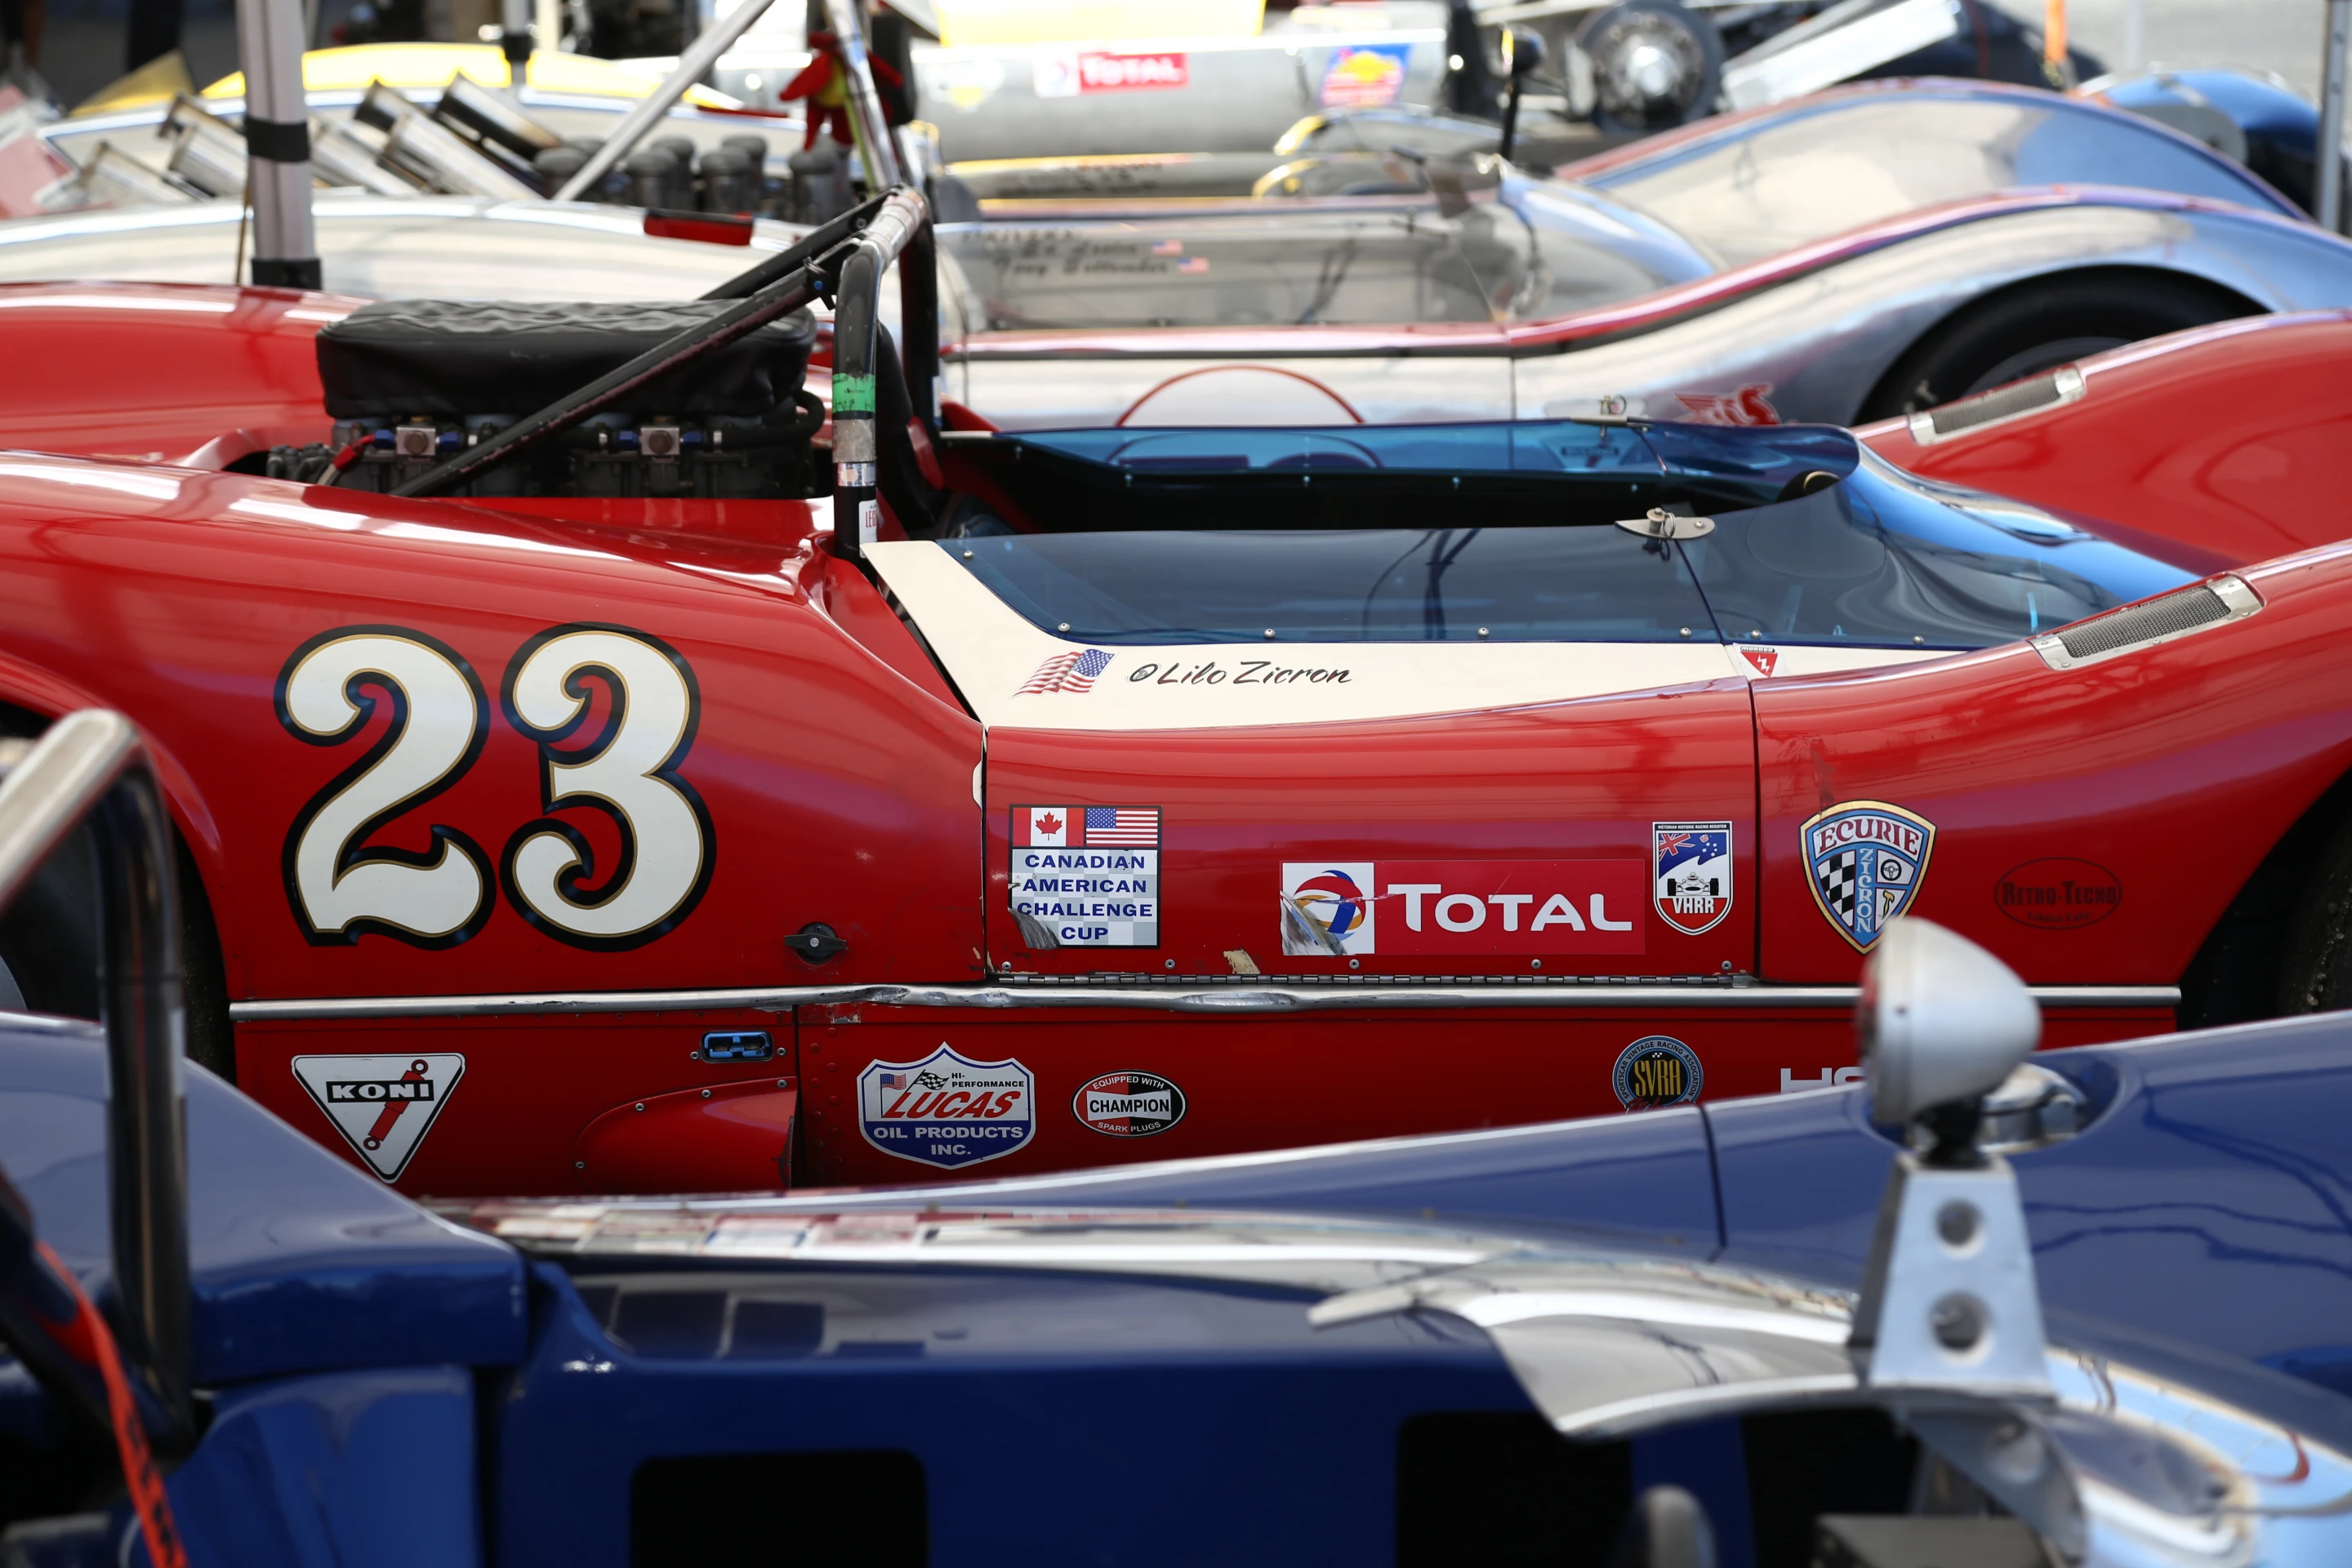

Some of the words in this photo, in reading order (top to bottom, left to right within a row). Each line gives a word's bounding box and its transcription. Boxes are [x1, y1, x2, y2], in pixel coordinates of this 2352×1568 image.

[1157, 662, 1227, 684] Lilo
[1232, 661, 1352, 684] Zicron
[274, 621, 717, 953] 23
[1818, 818, 1919, 856] ECURIE
[1025, 854, 1145, 869] CANADIAN
[1022, 879, 1147, 893] AMERICAN
[1855, 849, 1873, 933] ZICRON
[1017, 902, 1153, 917] CHALLENGE
[1388, 884, 1632, 932] TOTAL
[1673, 898, 1714, 914] VHRR
[1061, 927, 1108, 939] CUP
[1618, 1060, 1630, 1099] SPORTSCAR
[1626, 1041, 1655, 1060] VINTAGE
[1657, 1041, 1684, 1054] RACING
[1683, 1054, 1699, 1097] ASSOCIATION
[1092, 1076, 1139, 1090] EQUIPPED
[1142, 1077, 1165, 1089] WITH
[1634, 1059, 1681, 1097] SVRA
[332, 1084, 430, 1099] KONI
[882, 1091, 1021, 1118] LUCAS
[1089, 1099, 1169, 1112] CHAMPION
[873, 1127, 908, 1138] OIL
[915, 1126, 1023, 1138] PRODUCTS
[1098, 1121, 1128, 1132] SPARK
[1131, 1121, 1161, 1132] PLUGS
[931, 1144, 971, 1155] INC.
